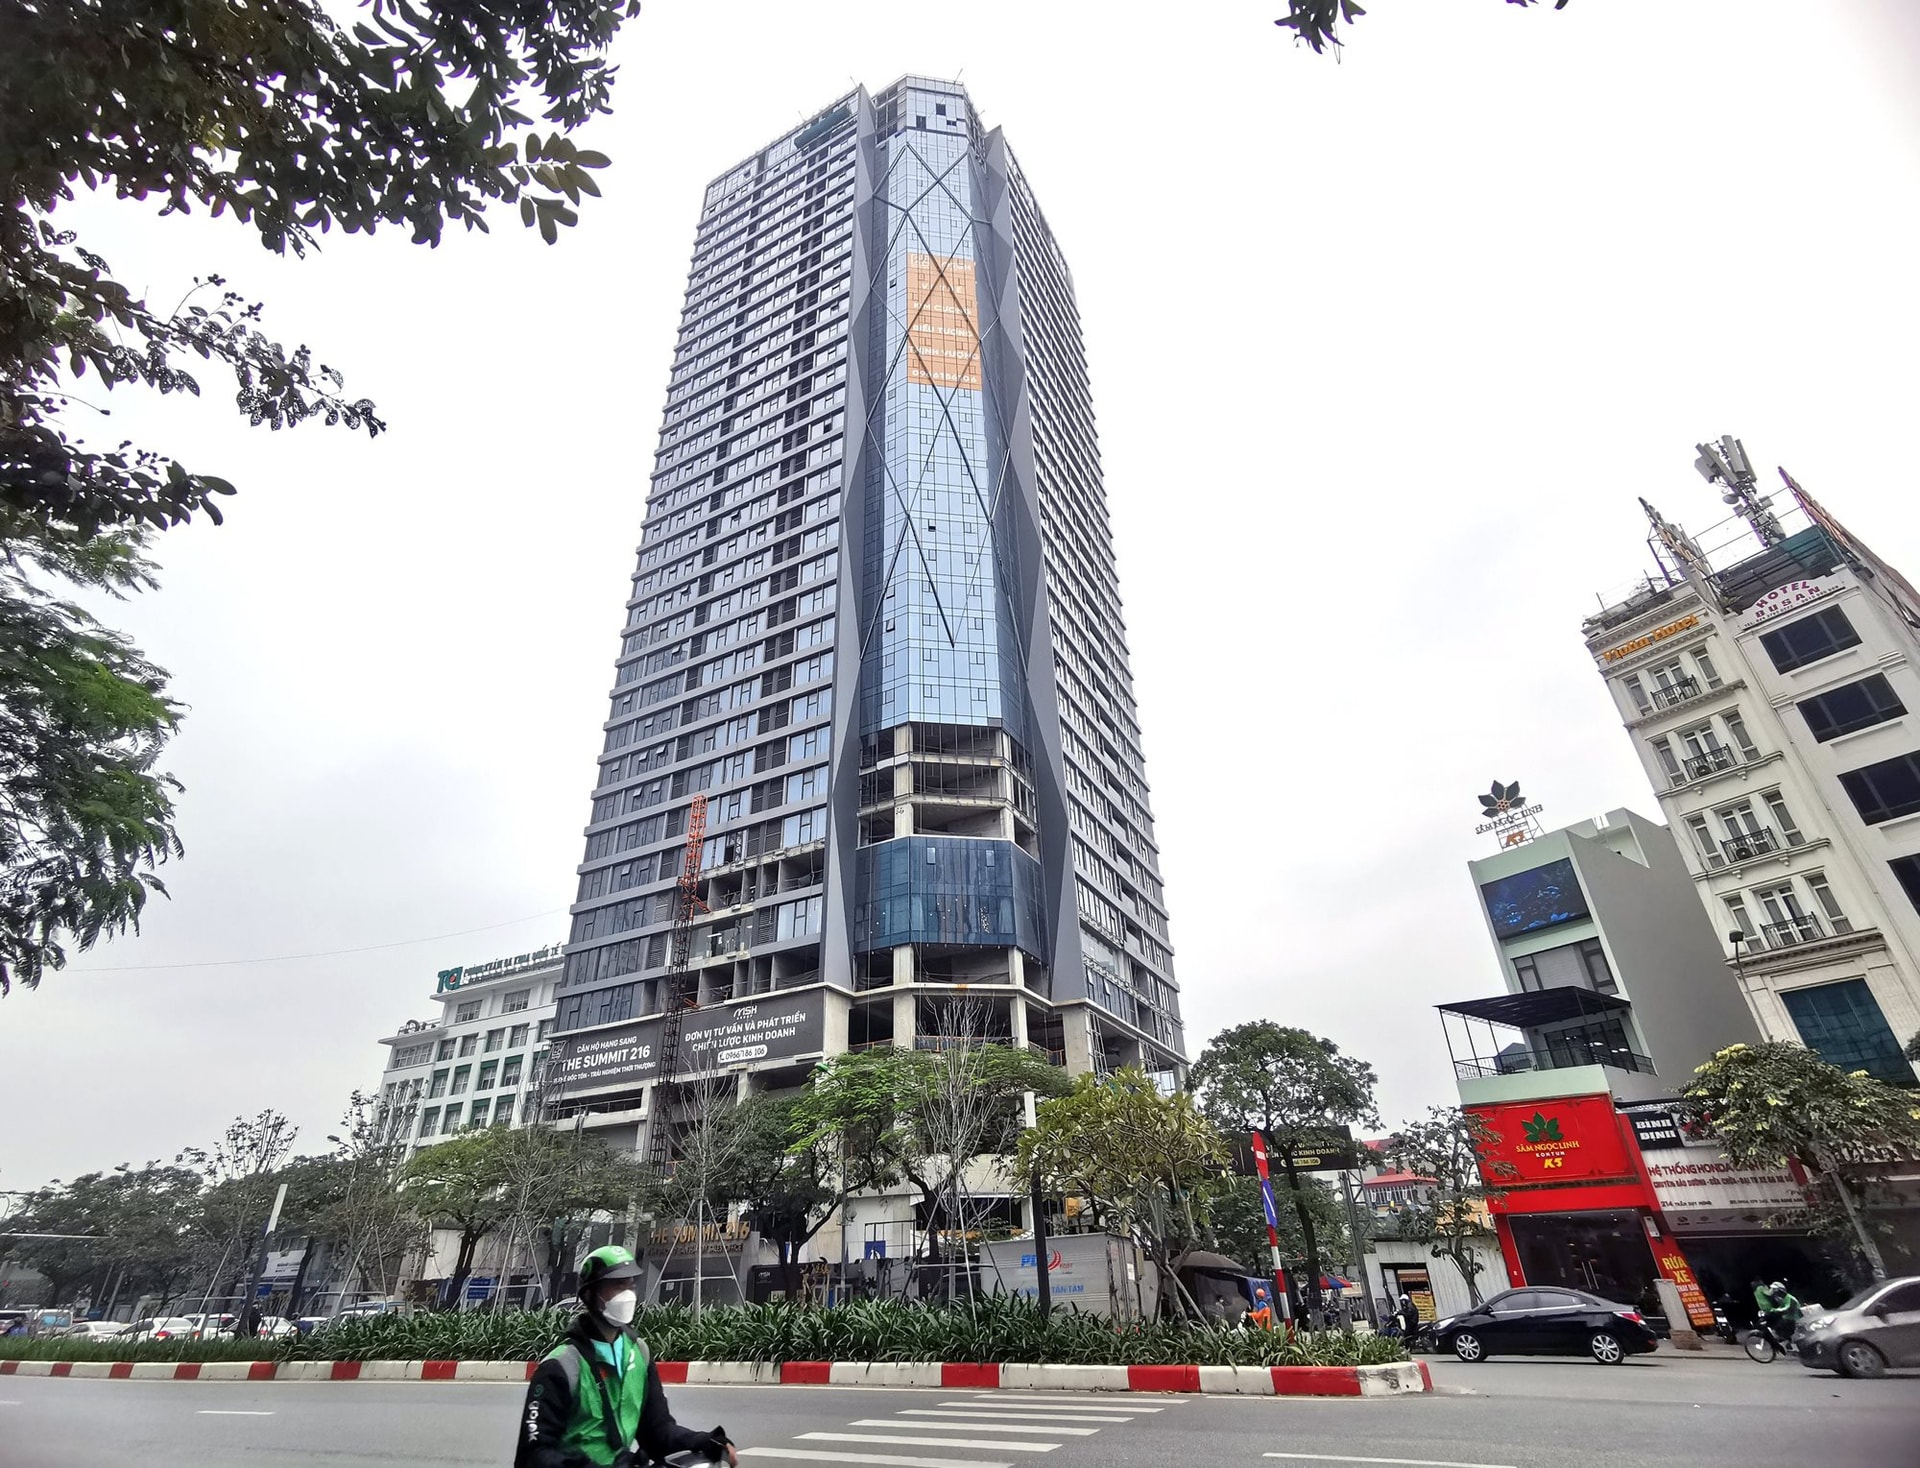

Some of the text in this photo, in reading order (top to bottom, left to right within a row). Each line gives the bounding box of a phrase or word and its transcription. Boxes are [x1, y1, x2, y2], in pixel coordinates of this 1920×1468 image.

[1755, 586, 1820, 618] BUSAN
[1756, 581, 1810, 609] HOTEL
[1521, 804, 1544, 818] LINH
[685, 1030, 703, 1042] ĐƠN
[703, 1029, 712, 1040] VỊ
[713, 1025, 727, 1037] TƯ
[726, 1022, 743, 1035] VẤN
[744, 1020, 756, 1031] VÀ
[757, 1016, 779, 1029] PHÁT
[780, 1010, 806, 1026] TRIỂN
[576, 1036, 638, 1054] CĂN HỘ HẠNG SANG
[718, 1036, 741, 1048] LƯỢC
[742, 1032, 763, 1044] KINH
[765, 1027, 796, 1041] DOANH
[561, 1045, 651, 1072] THE SUMMIT 216
[1635, 1119, 1673, 1129] BÌNH
[1639, 1130, 1677, 1141] ĐỊNH
[1299, 1149, 1315, 1157] KINH
[1516, 1140, 1580, 1153] SÂM NGỌC LINH
[1543, 1157, 1563, 1169] K5
[1648, 1164, 1663, 1177] HỆ
[1662, 1161, 1697, 1176] THỐNG
[1695, 1162, 1734, 1175] HONDA
[725, 1220, 750, 1240] 216
[1661, 1252, 1688, 1270] RỬA
[1672, 1269, 1692, 1283] XE
[526, 1400, 540, 1442] gojek
